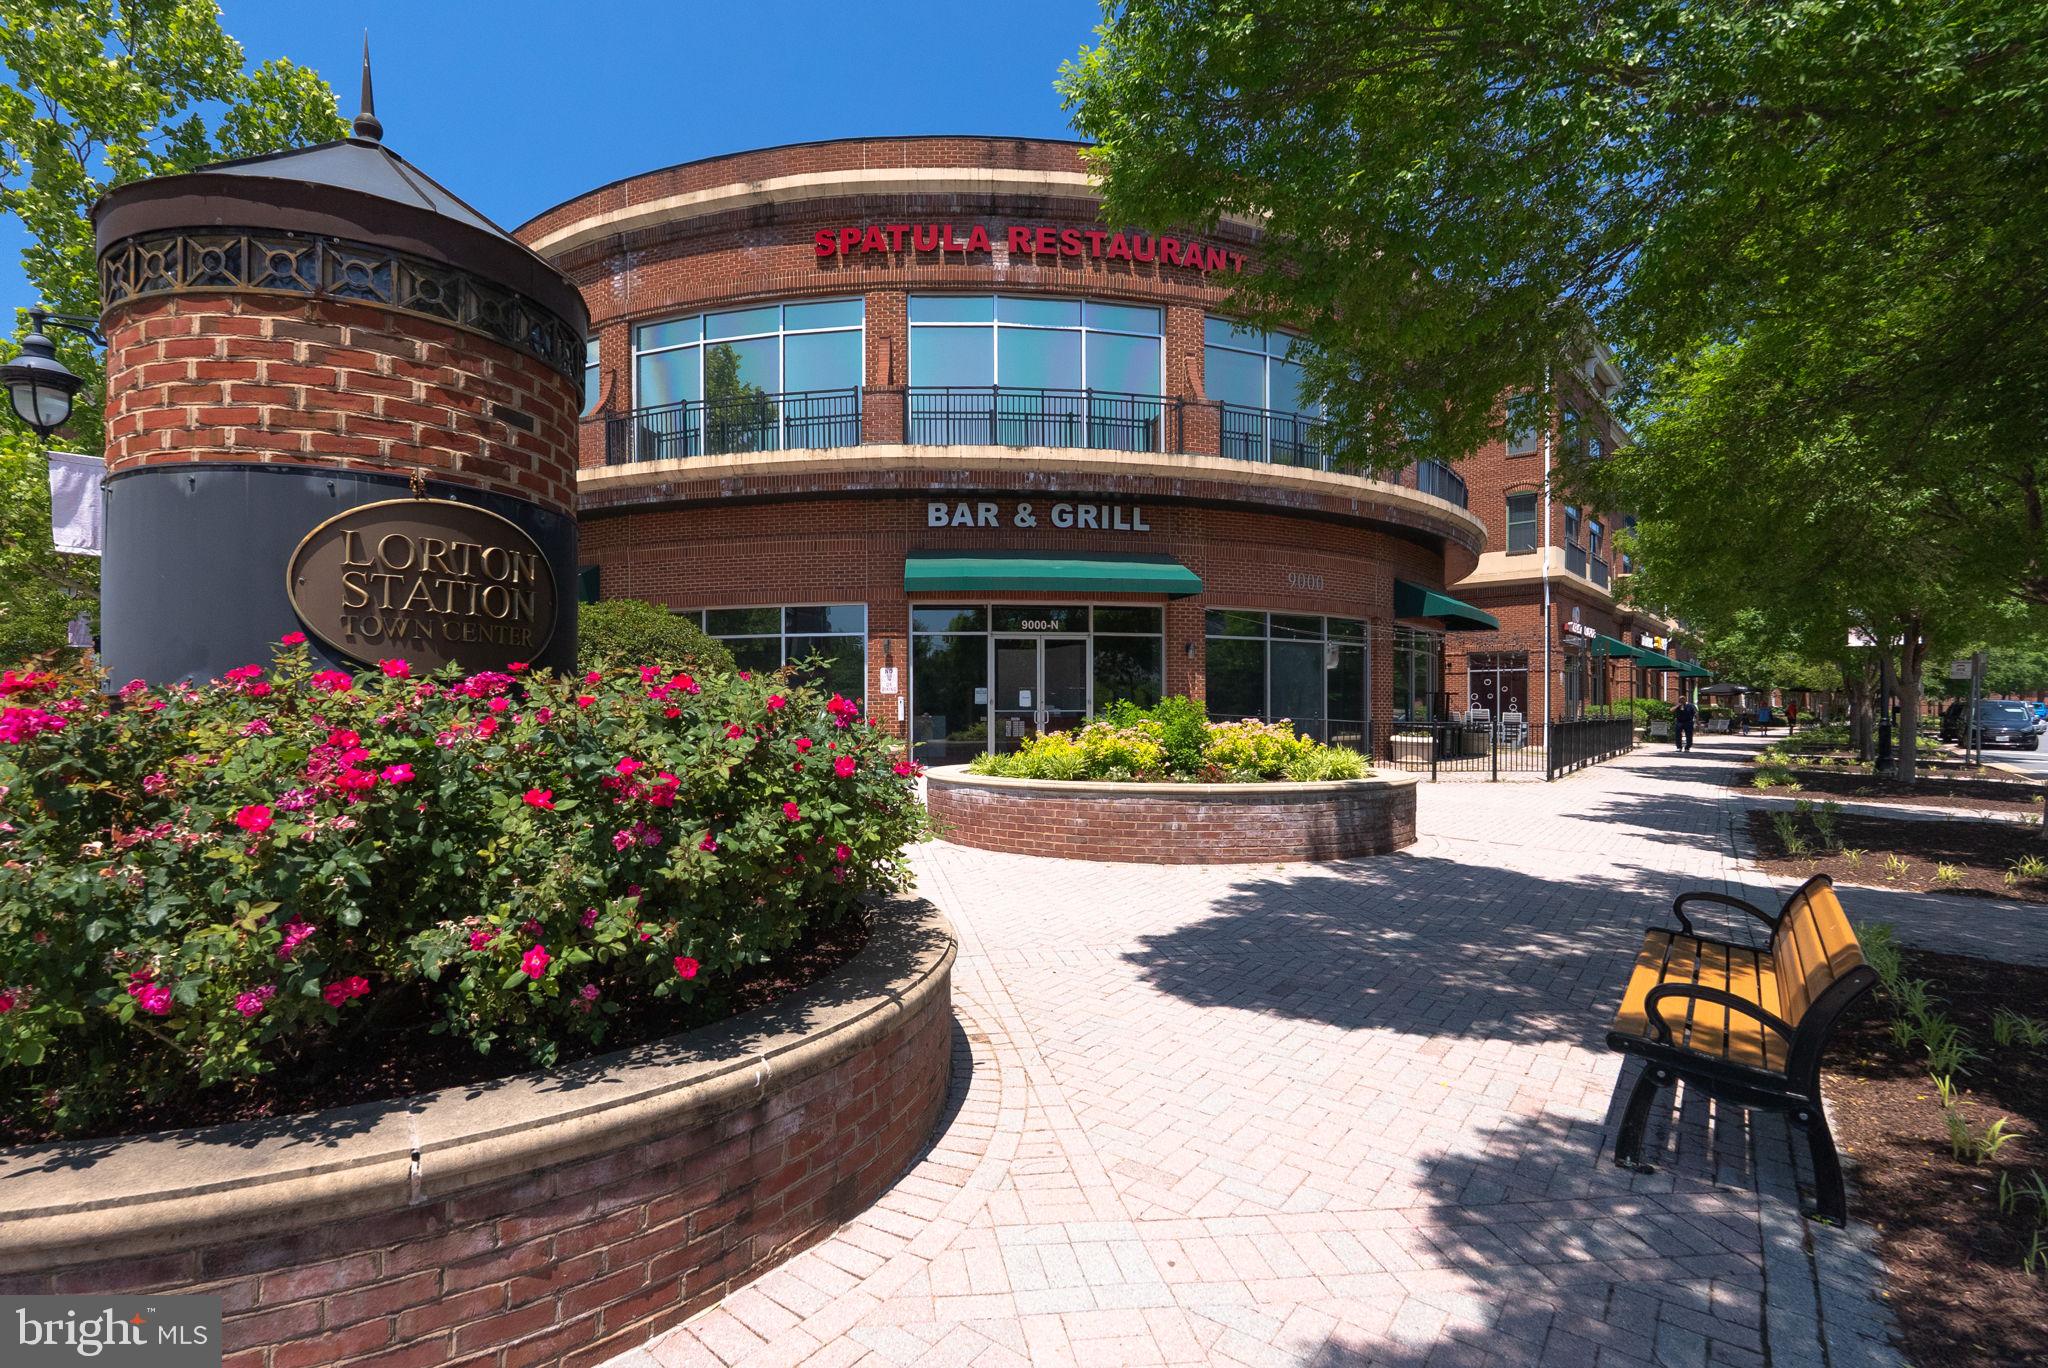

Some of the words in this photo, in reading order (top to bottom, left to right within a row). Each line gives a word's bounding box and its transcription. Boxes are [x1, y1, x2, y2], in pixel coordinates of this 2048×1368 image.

[814, 224, 992, 257] SPATULA
[1007, 226, 1248, 273] RESTAURANT
[927, 502, 1000, 527] BAR
[1013, 502, 1037, 528] &
[1051, 503, 1150, 532] GRILL
[339, 529, 538, 584] LORTON
[341, 571, 537, 623] STATION
[1288, 572, 1324, 591] 9000
[340, 614, 434, 640] TOWN
[441, 619, 534, 648] CENTER
[1021, 619, 1059, 630] 9000-N
